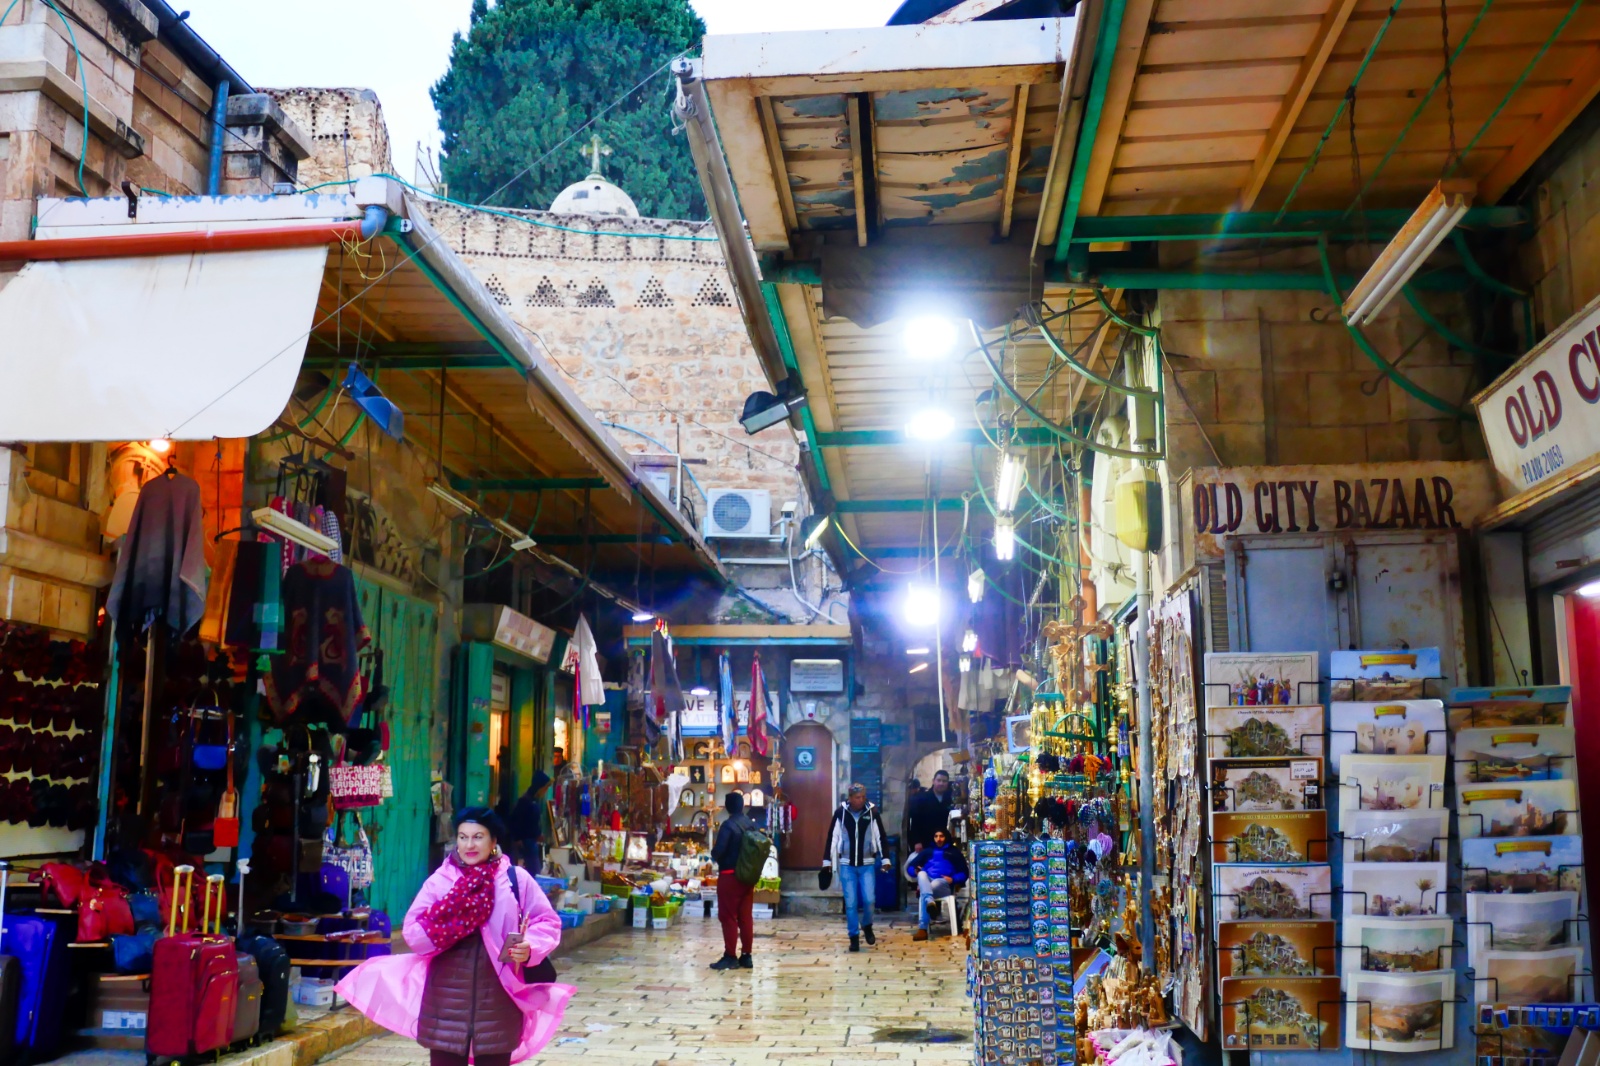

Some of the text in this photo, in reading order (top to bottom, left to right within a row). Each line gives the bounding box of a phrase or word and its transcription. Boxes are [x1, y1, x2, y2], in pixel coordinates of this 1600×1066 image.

[1505, 370, 1562, 449] OLD
[1193, 475, 1461, 534] OLD CITY BAZAAR
